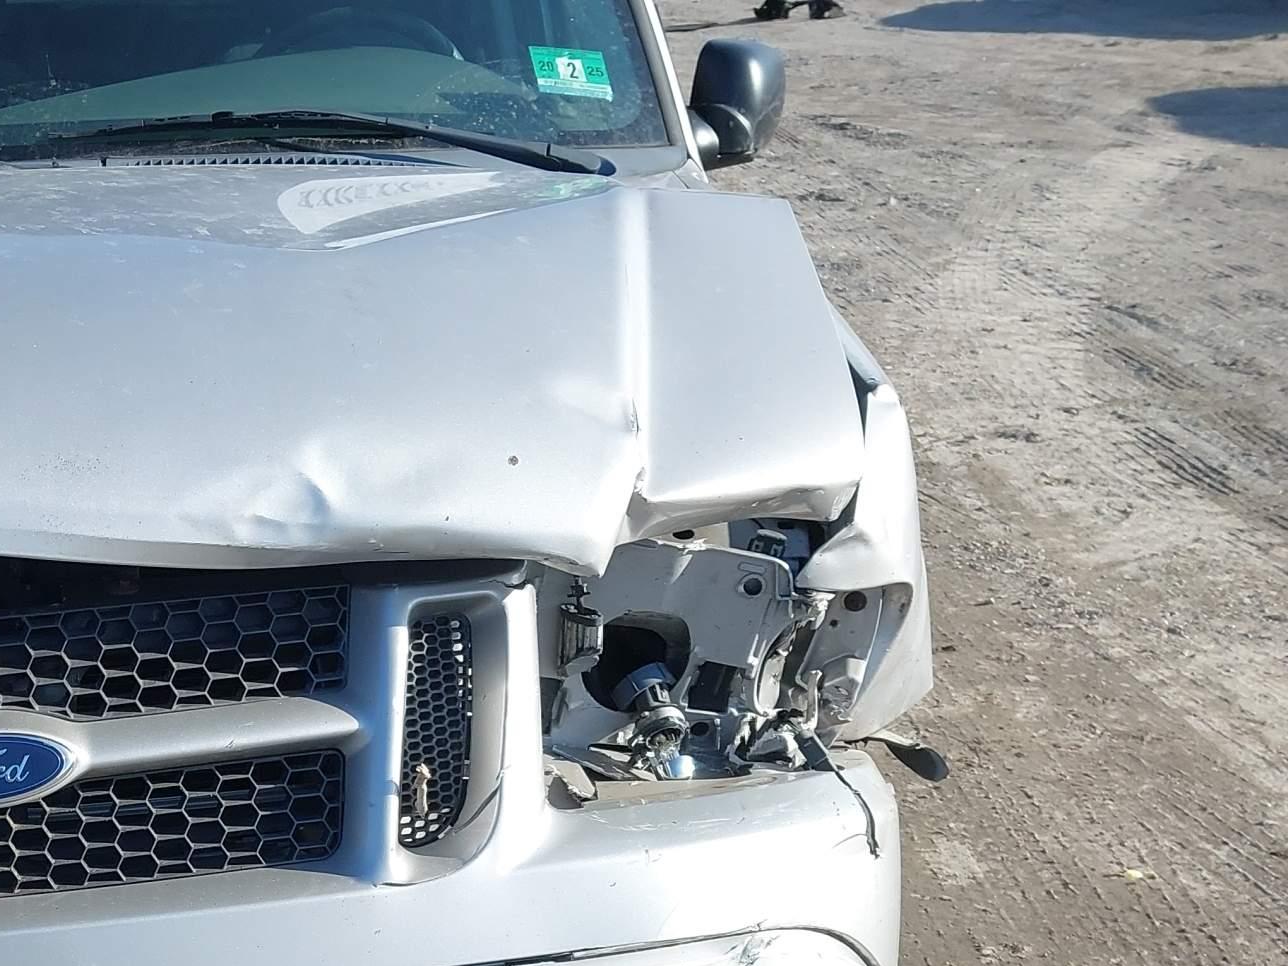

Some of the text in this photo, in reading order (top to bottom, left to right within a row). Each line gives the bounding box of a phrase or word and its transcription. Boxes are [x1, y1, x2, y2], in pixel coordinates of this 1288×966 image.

[538, 60, 604, 79] 20 2 25
